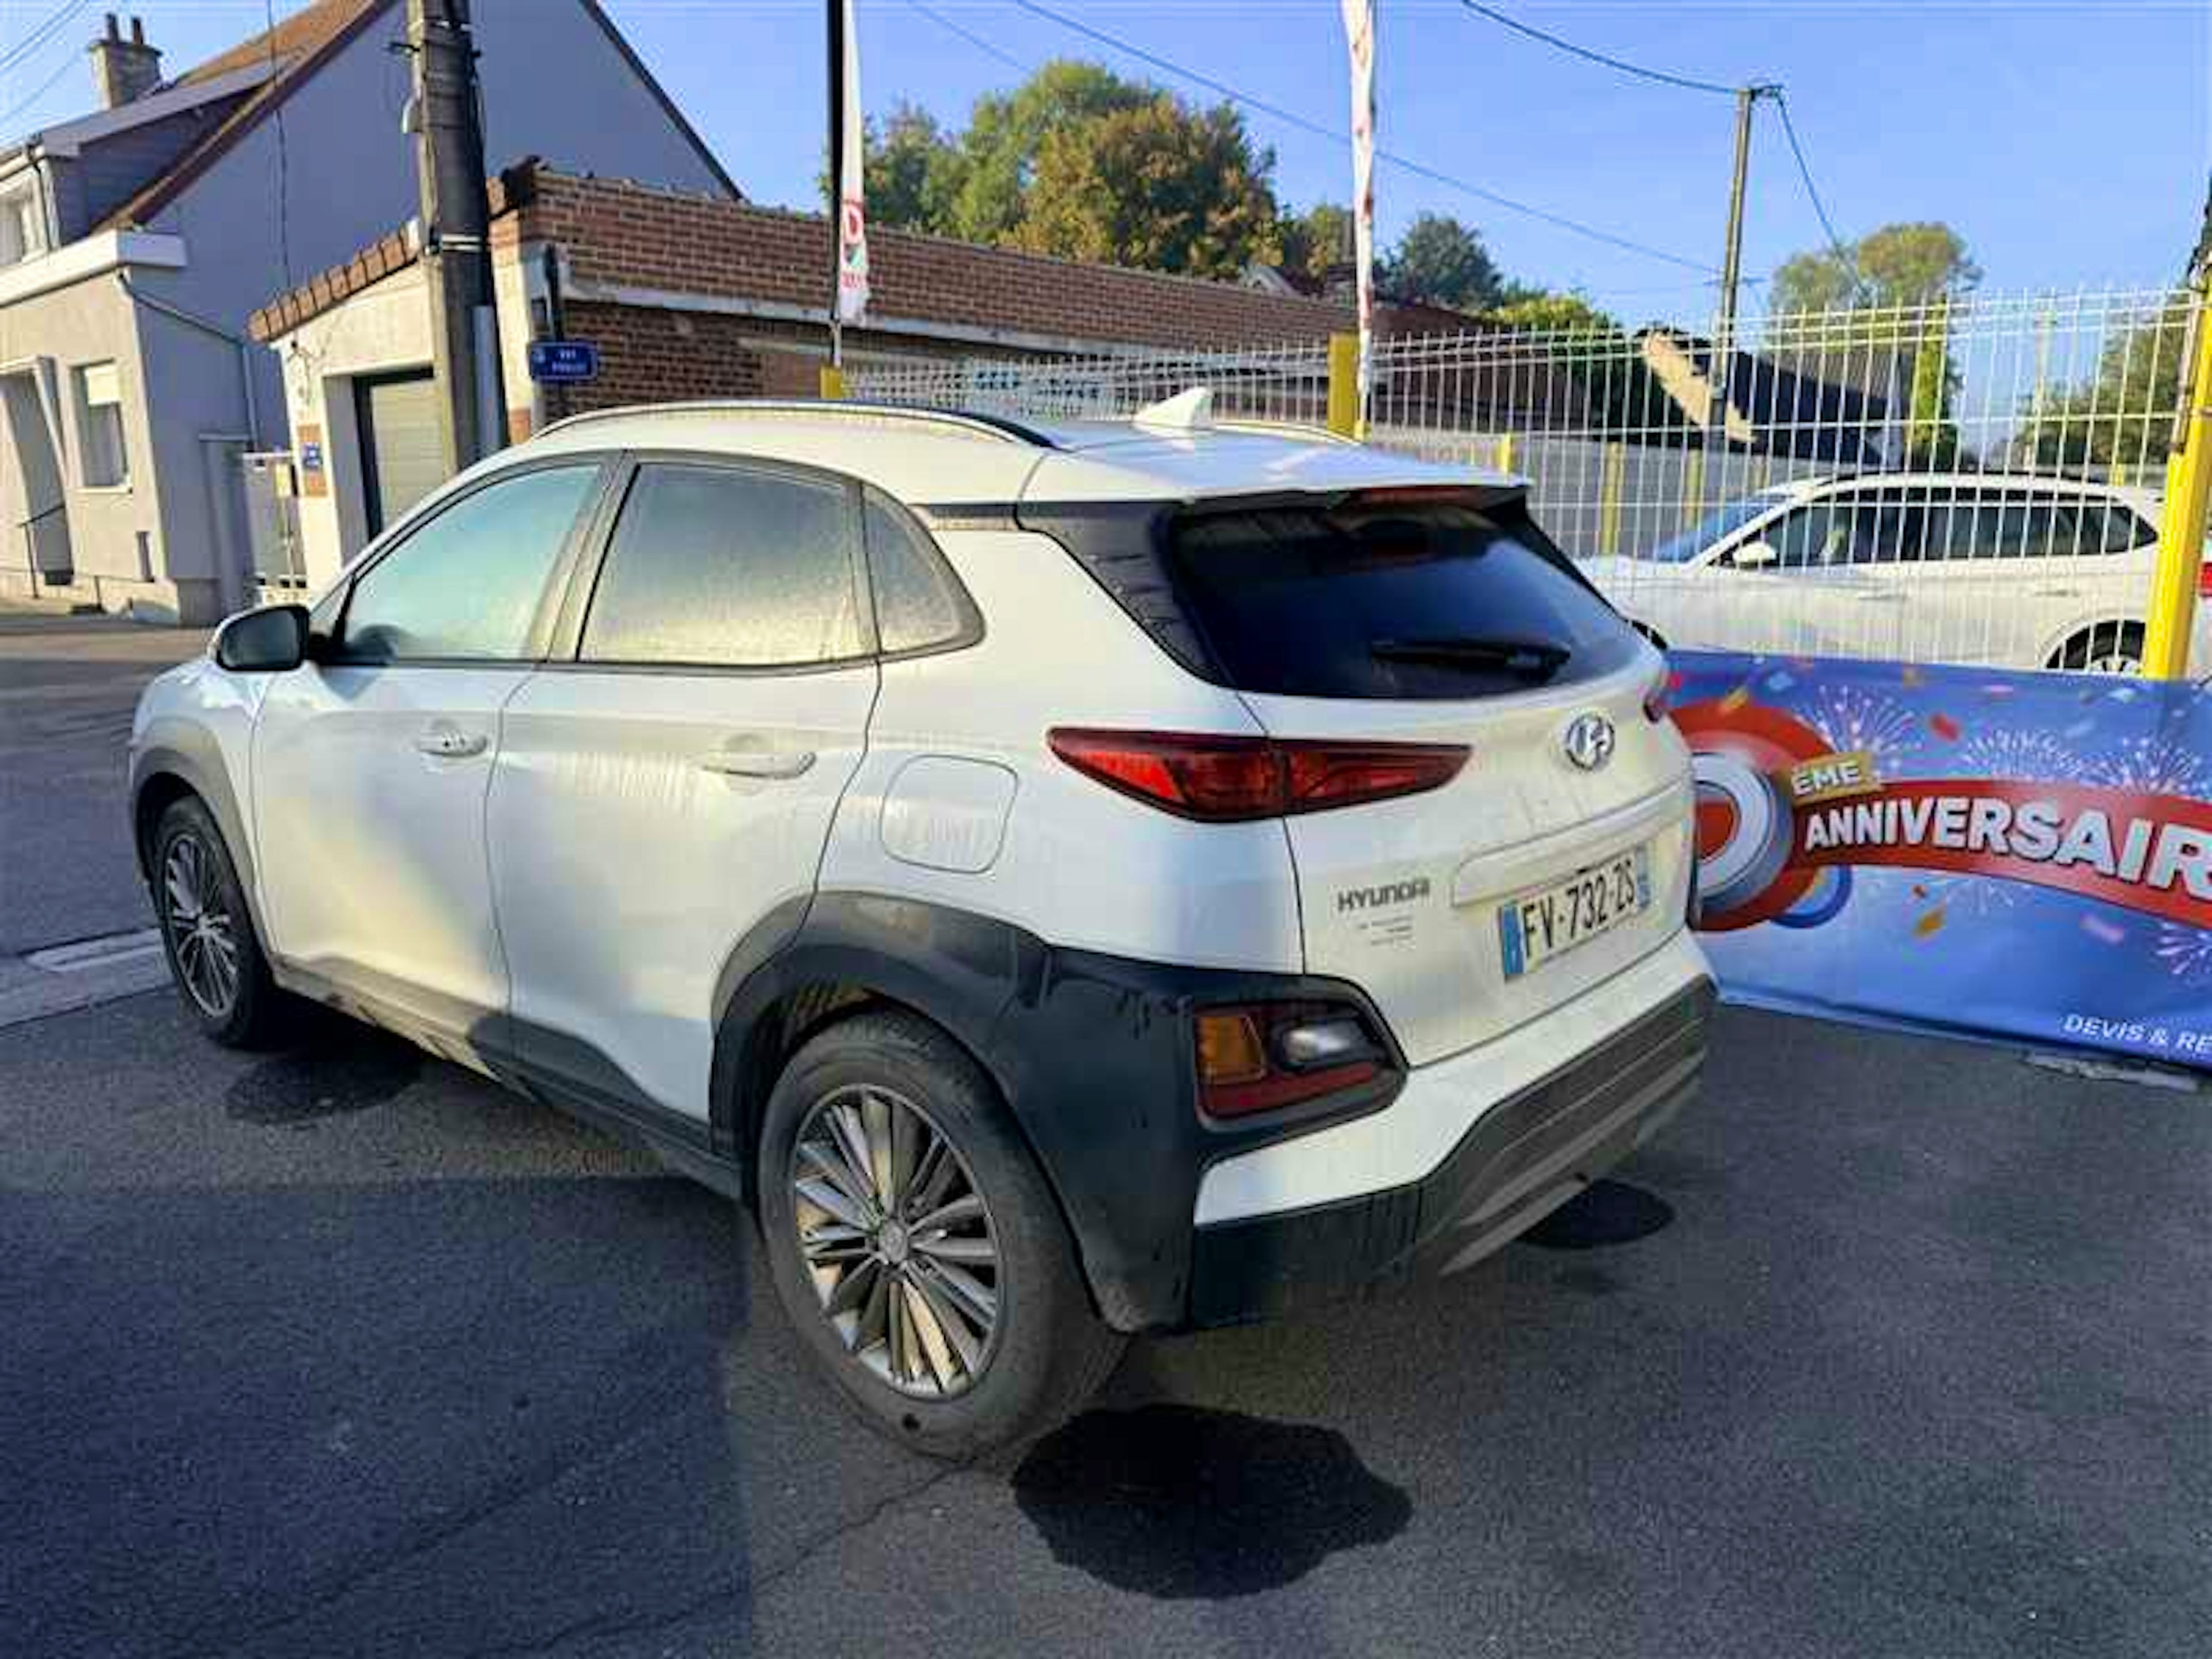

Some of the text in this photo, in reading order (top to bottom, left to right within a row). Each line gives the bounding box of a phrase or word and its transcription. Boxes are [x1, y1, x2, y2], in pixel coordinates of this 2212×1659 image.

[1804, 796, 2212, 900] ANNIVERSAIR
[1338, 877, 1430, 912] HYUNDAI
[2064, 1014, 2144, 1042] DEVIS
